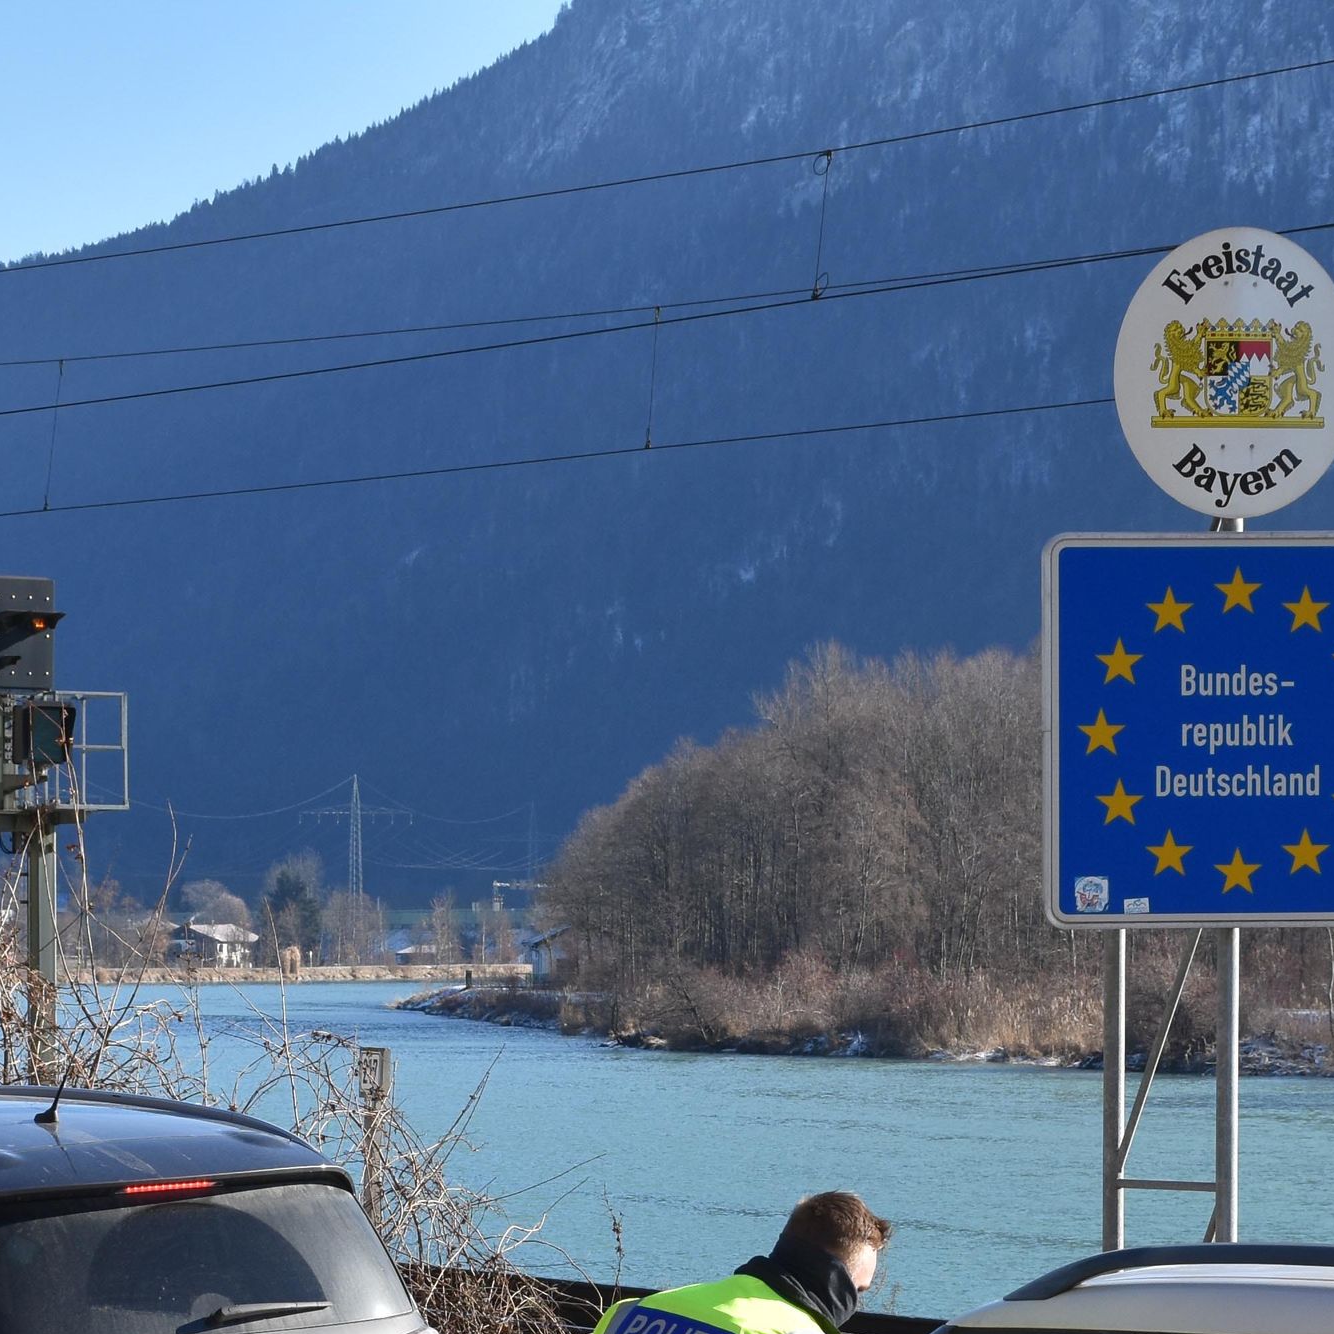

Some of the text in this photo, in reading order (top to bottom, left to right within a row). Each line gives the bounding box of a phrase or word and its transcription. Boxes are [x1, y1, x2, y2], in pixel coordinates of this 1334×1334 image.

[1162, 242, 1315, 307] Freistaat
[1172, 444, 1302, 508] Bayern
[1180, 664, 1295, 697] Bundes-
[1181, 714, 1294, 755] republik
[1155, 764, 1321, 798] Deutschland
